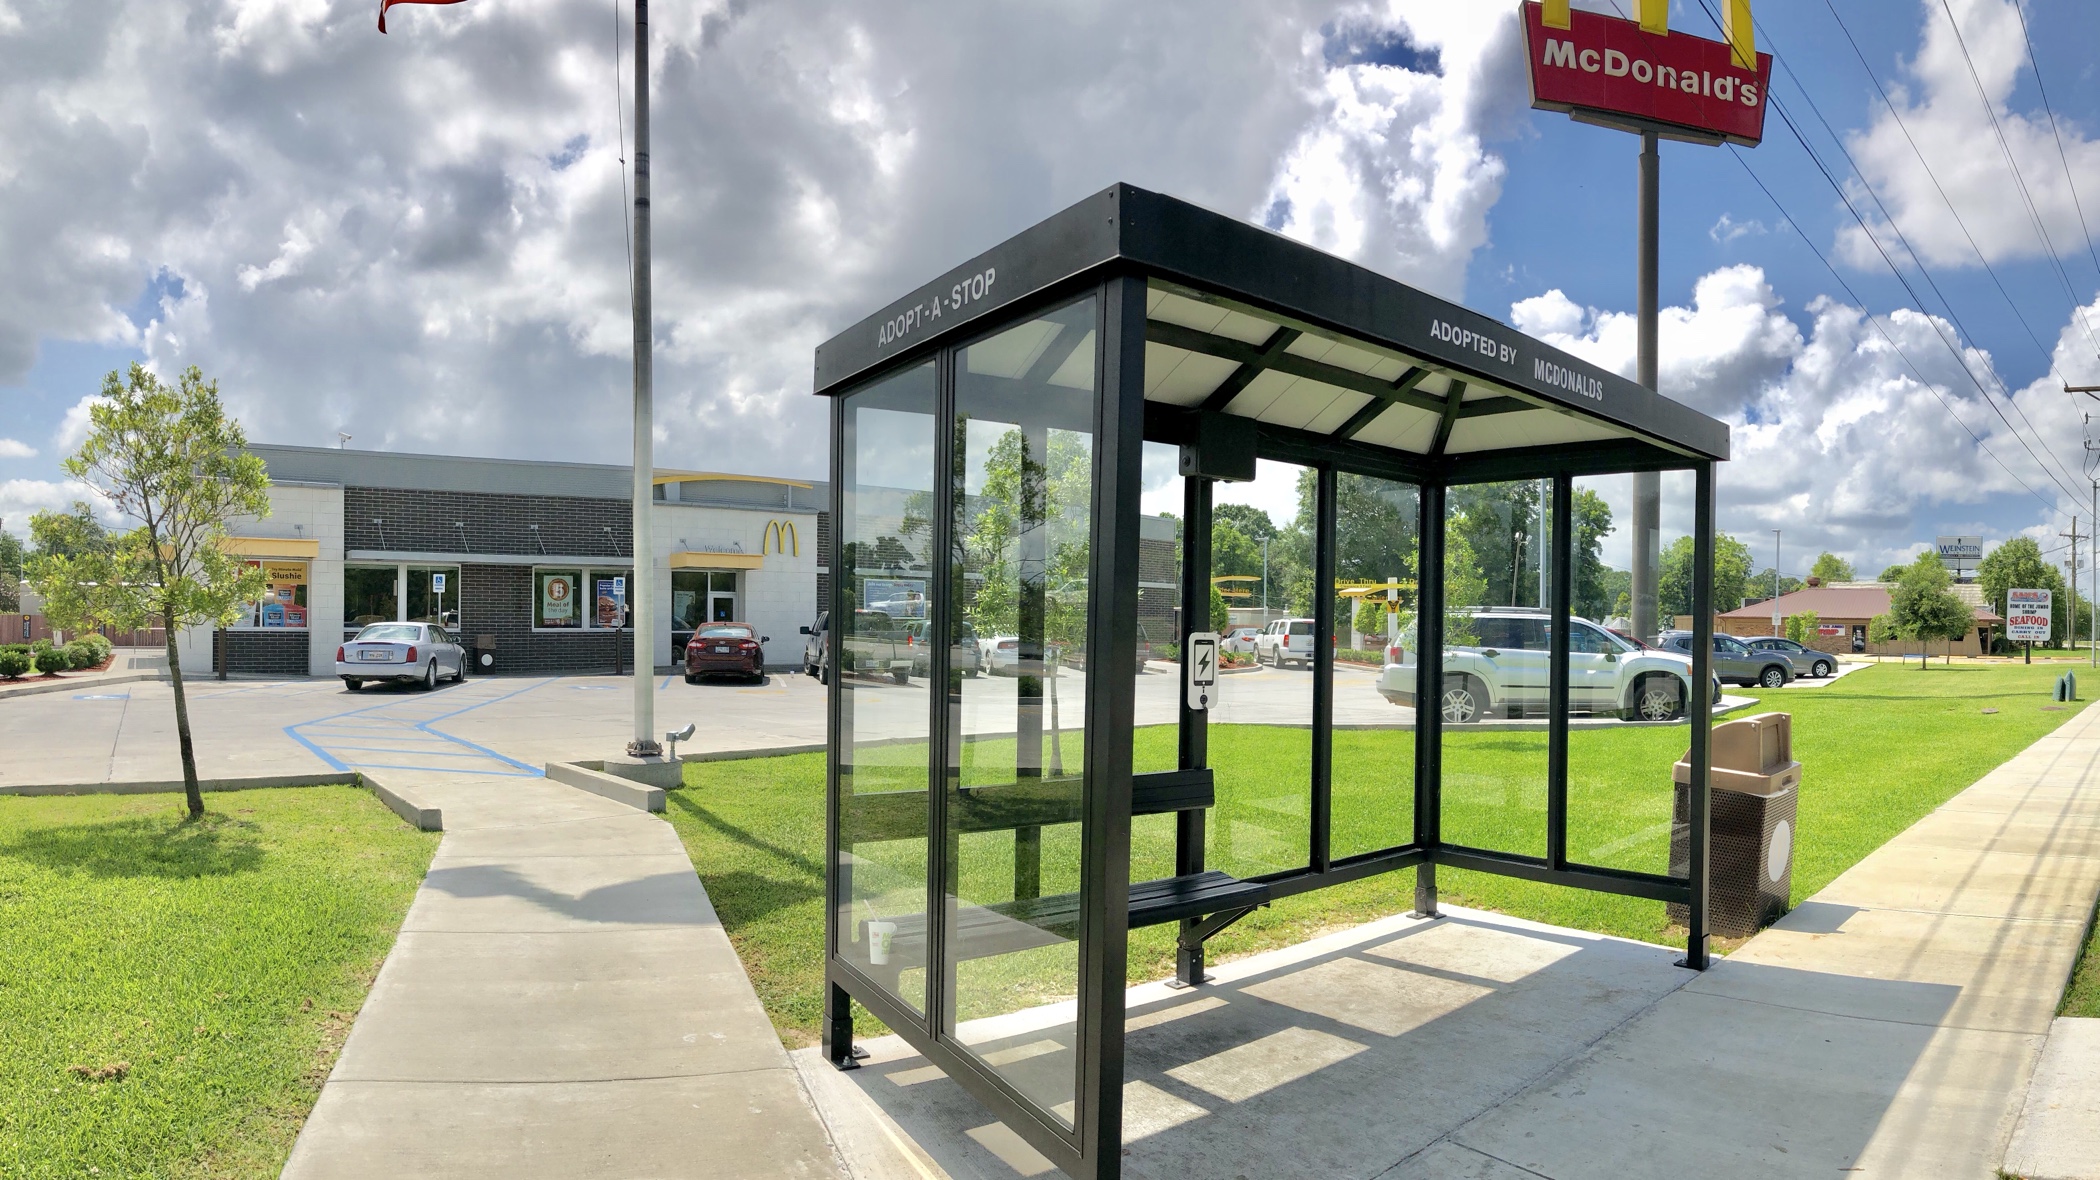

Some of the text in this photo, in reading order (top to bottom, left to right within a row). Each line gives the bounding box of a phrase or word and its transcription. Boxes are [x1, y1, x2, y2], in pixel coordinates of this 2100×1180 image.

[1542, 38, 1759, 107] McDonald's
[878, 267, 996, 348] ADOPT-A-STOP
[1430, 319, 1603, 401] ADOPTED BY MCDONALDS
[271, 572, 302, 580] Slushie
[2010, 616, 2048, 626] SEAFOOD
